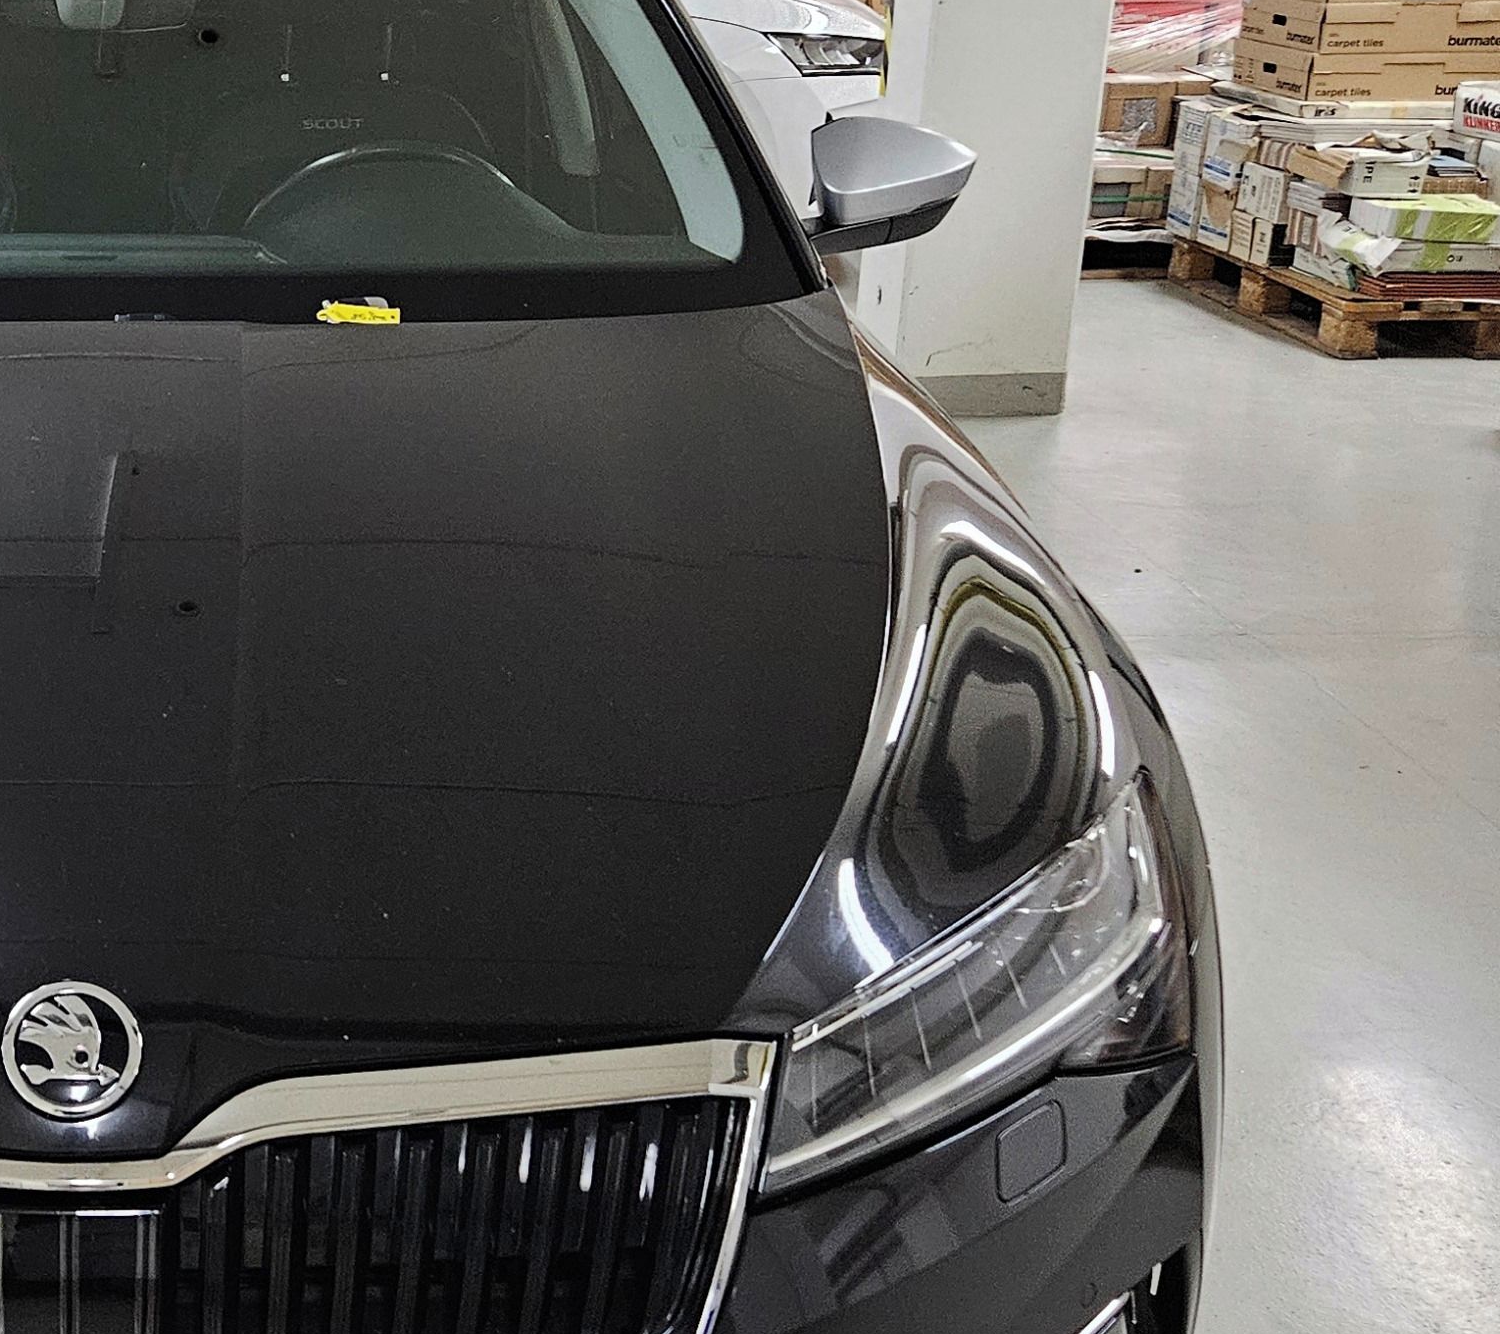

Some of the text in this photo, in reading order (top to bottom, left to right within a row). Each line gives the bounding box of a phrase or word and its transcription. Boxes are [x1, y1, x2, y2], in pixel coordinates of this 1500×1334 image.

[1327, 39, 1384, 48] carpet tiles
[1315, 88, 1371, 98] carpet tiles
[302, 117, 364, 130] SCOUT
